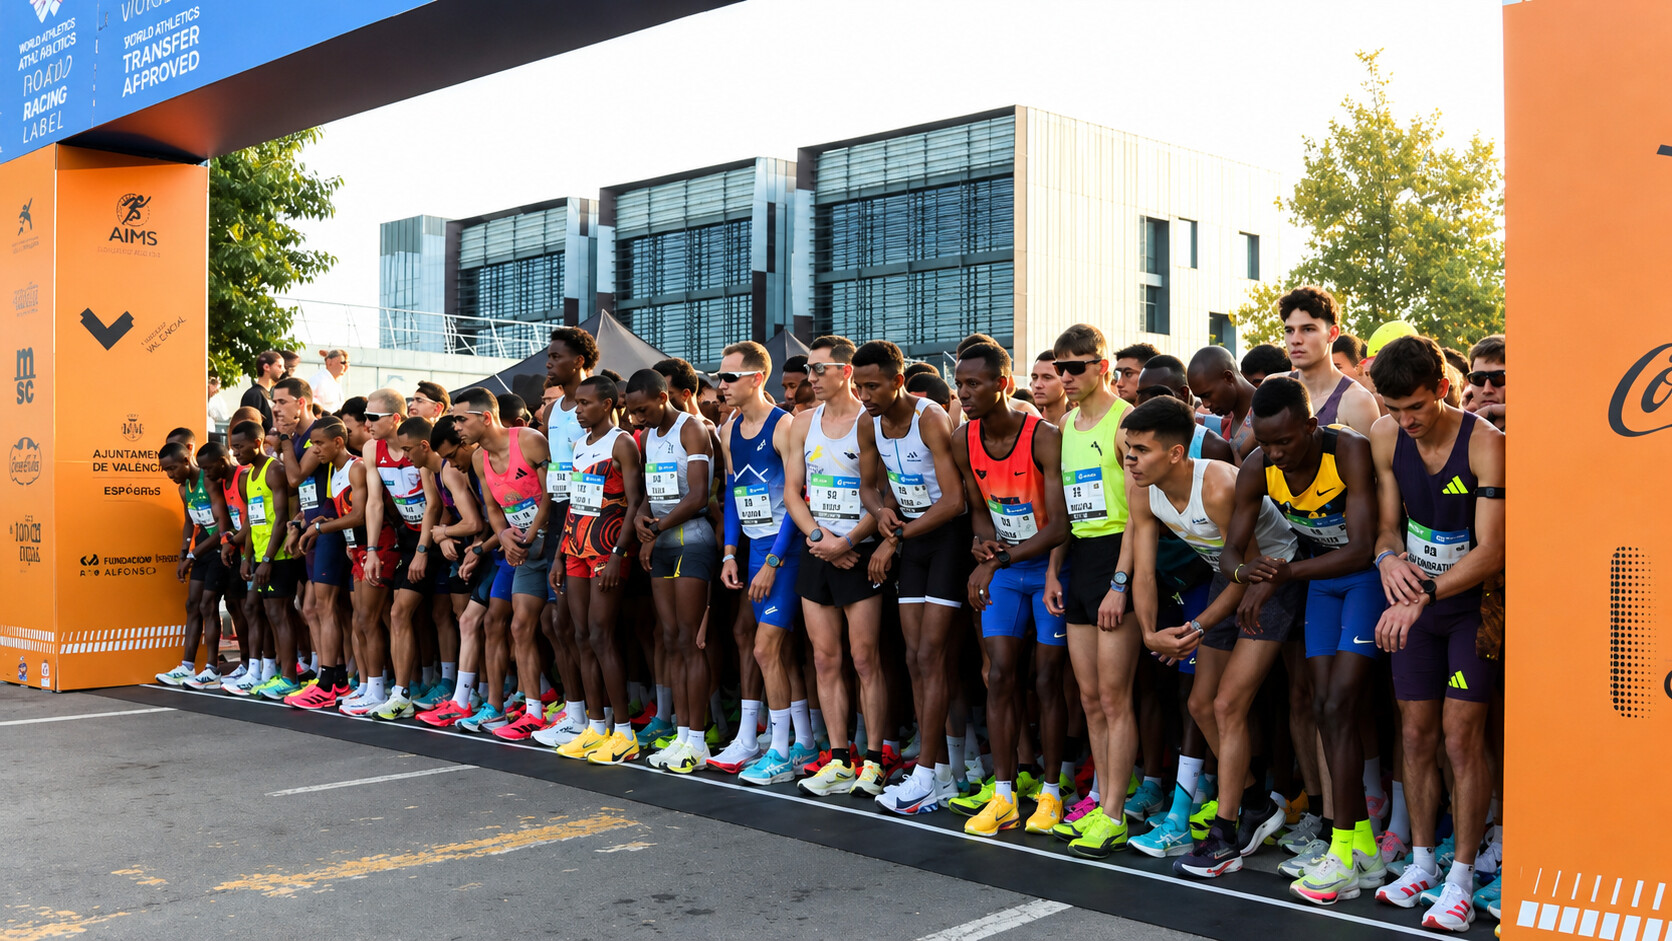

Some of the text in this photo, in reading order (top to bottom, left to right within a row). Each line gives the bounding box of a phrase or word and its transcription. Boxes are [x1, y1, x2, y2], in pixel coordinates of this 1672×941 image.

[155, 6, 200, 36] ATHLETICS
[123, 25, 200, 73] TRANSFER
[23, 86, 67, 121] RACING
[23, 110, 64, 144] LABEL
[108, 226, 158, 246] AIMS
[92, 449, 160, 459] AJUNTAMEN
[92, 462, 109, 472] DE
